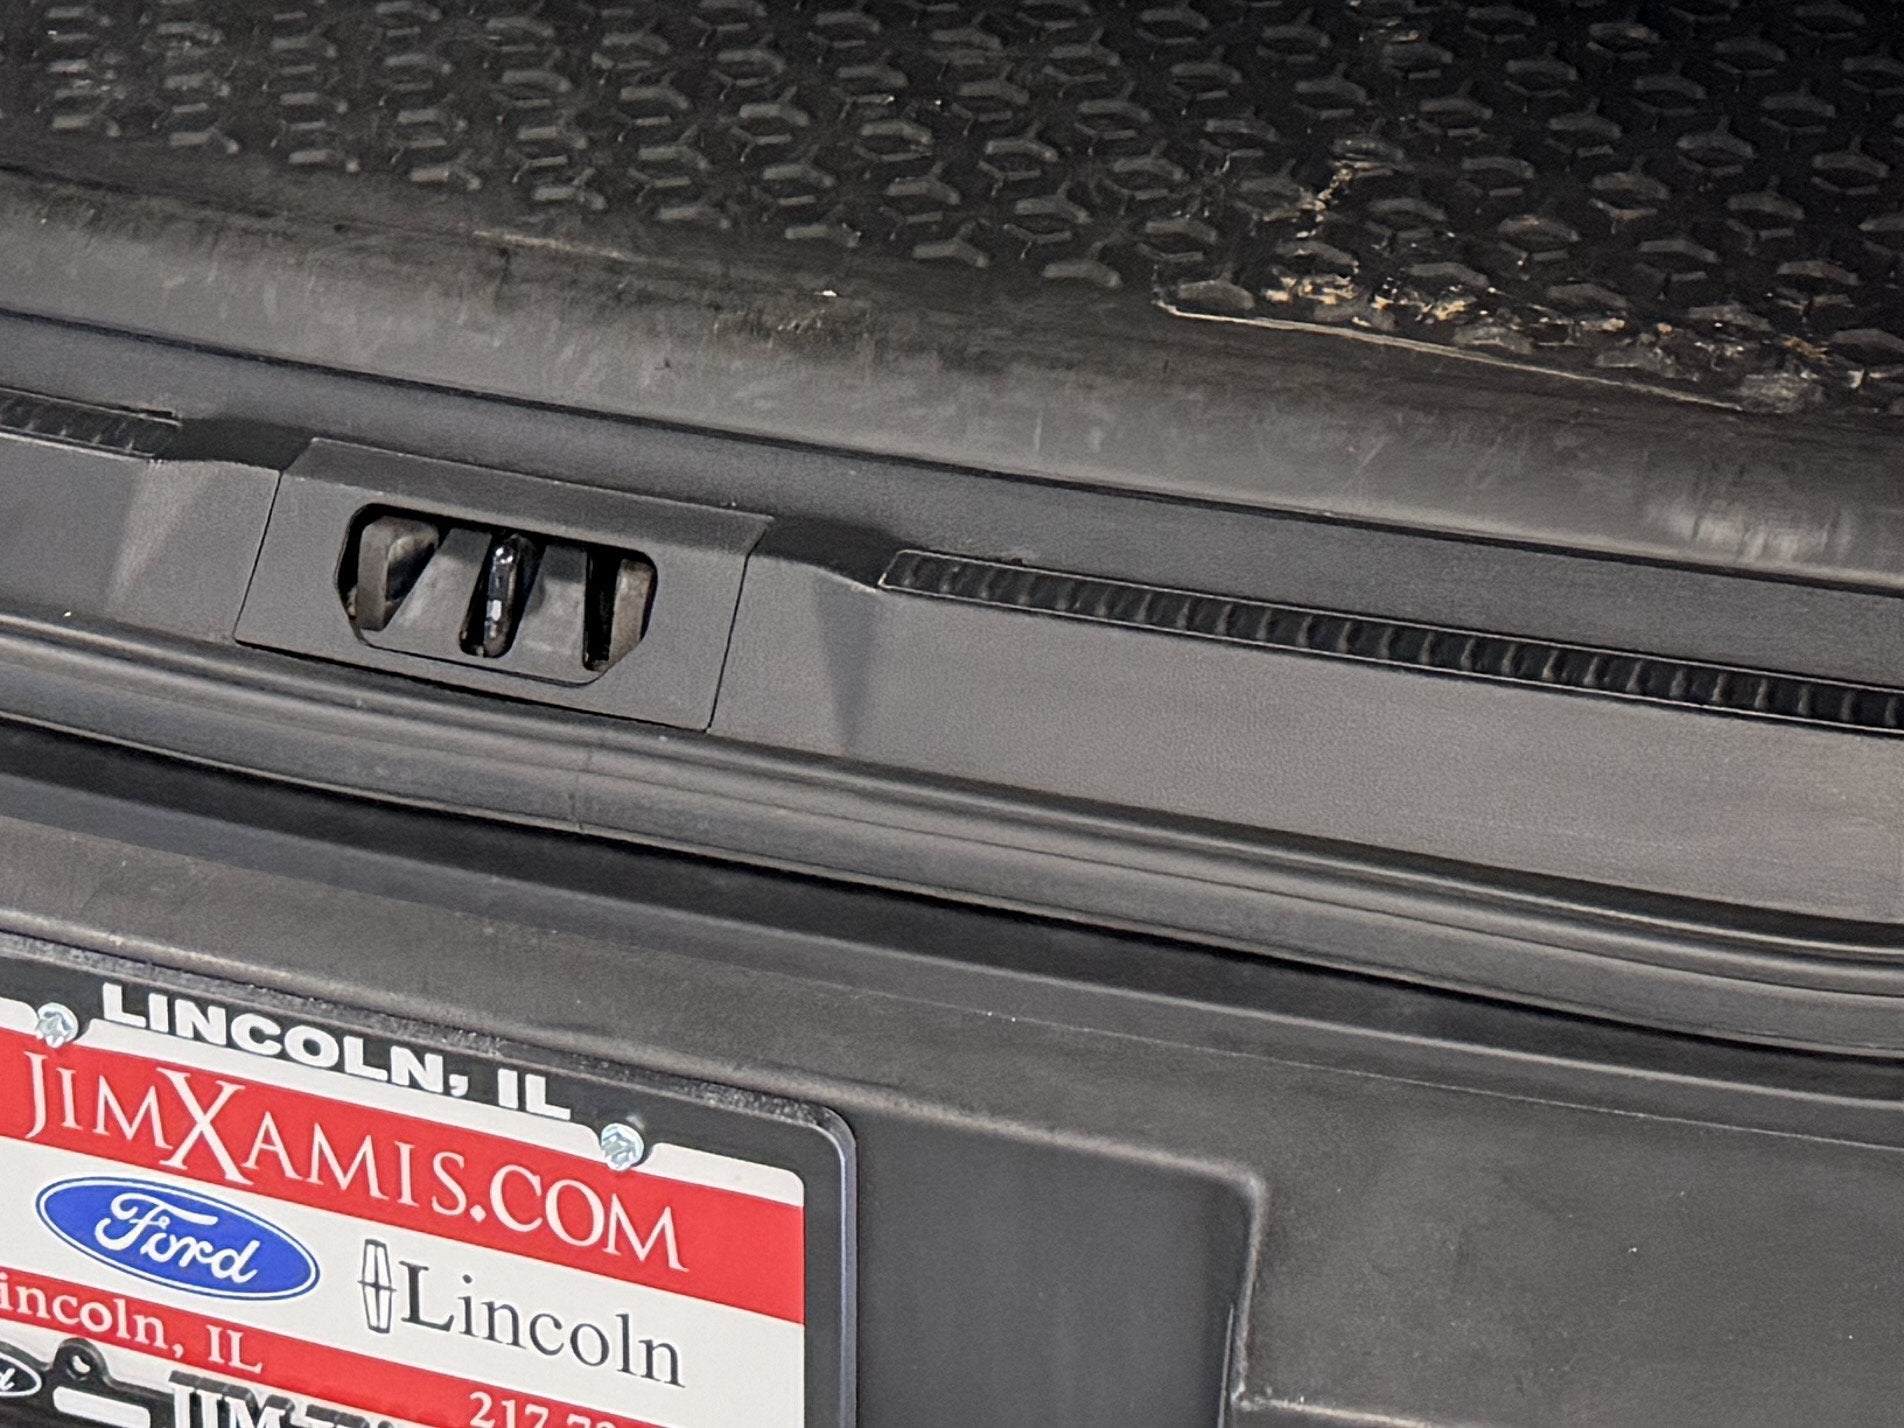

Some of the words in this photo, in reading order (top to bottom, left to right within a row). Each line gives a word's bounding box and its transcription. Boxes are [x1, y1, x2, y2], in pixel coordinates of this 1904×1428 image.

[102, 981, 470, 1097] LINCOLN,
[497, 1068, 572, 1120] IL
[94, 1191, 260, 1284] Ford
[206, 1324, 263, 1374] IL
[399, 1260, 686, 1389] Lincoln
